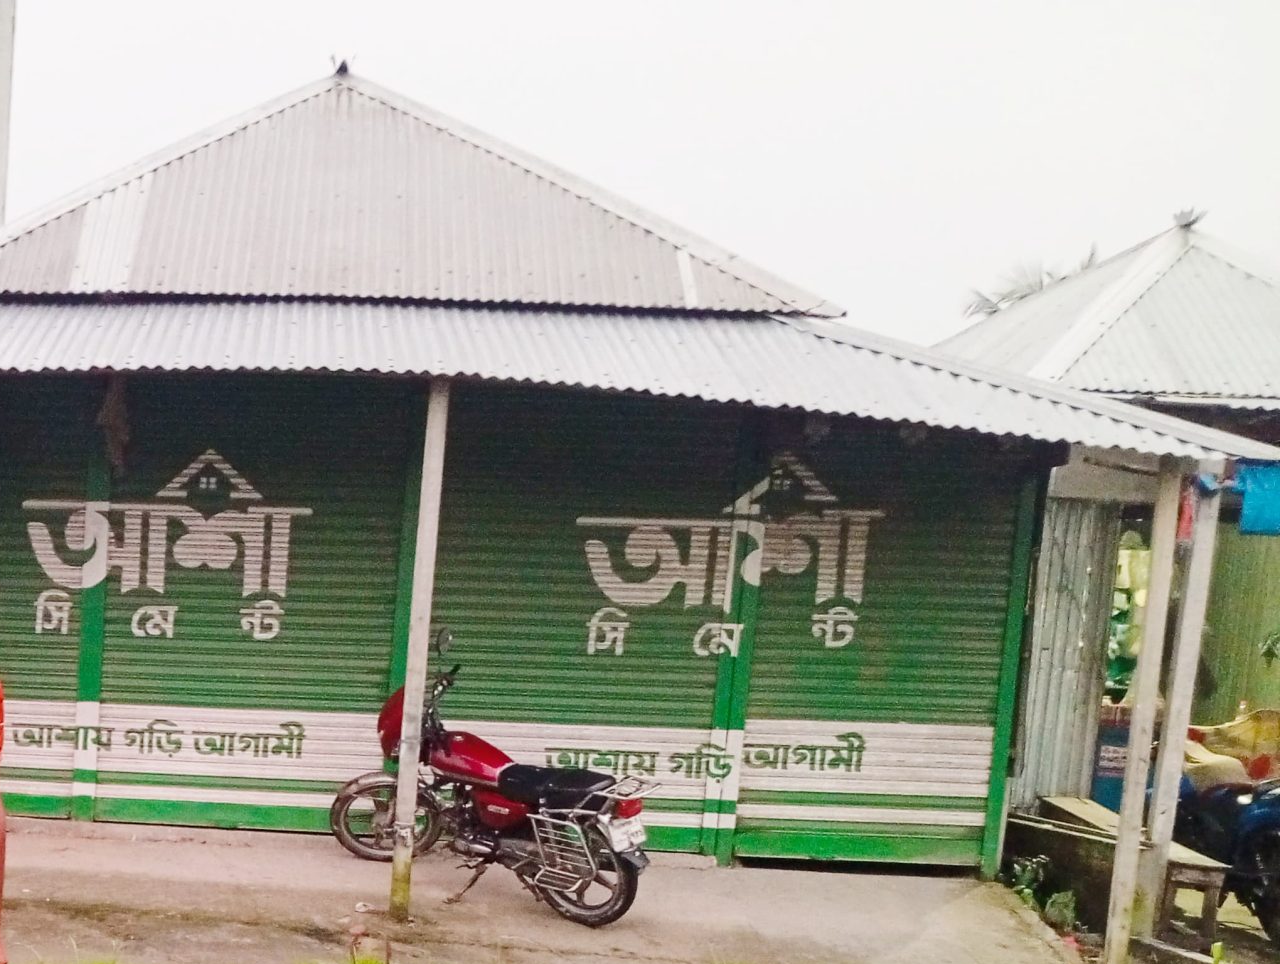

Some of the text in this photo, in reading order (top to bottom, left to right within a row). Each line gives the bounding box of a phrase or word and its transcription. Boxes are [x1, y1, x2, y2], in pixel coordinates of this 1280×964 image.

[23, 499, 313, 598] আশা
[576, 508, 886, 614] আশা
[12, 719, 306, 759] আশায় গড়ি আগামী
[668, 743, 735, 783] গড়ি
[742, 732, 866, 773] আগামী
